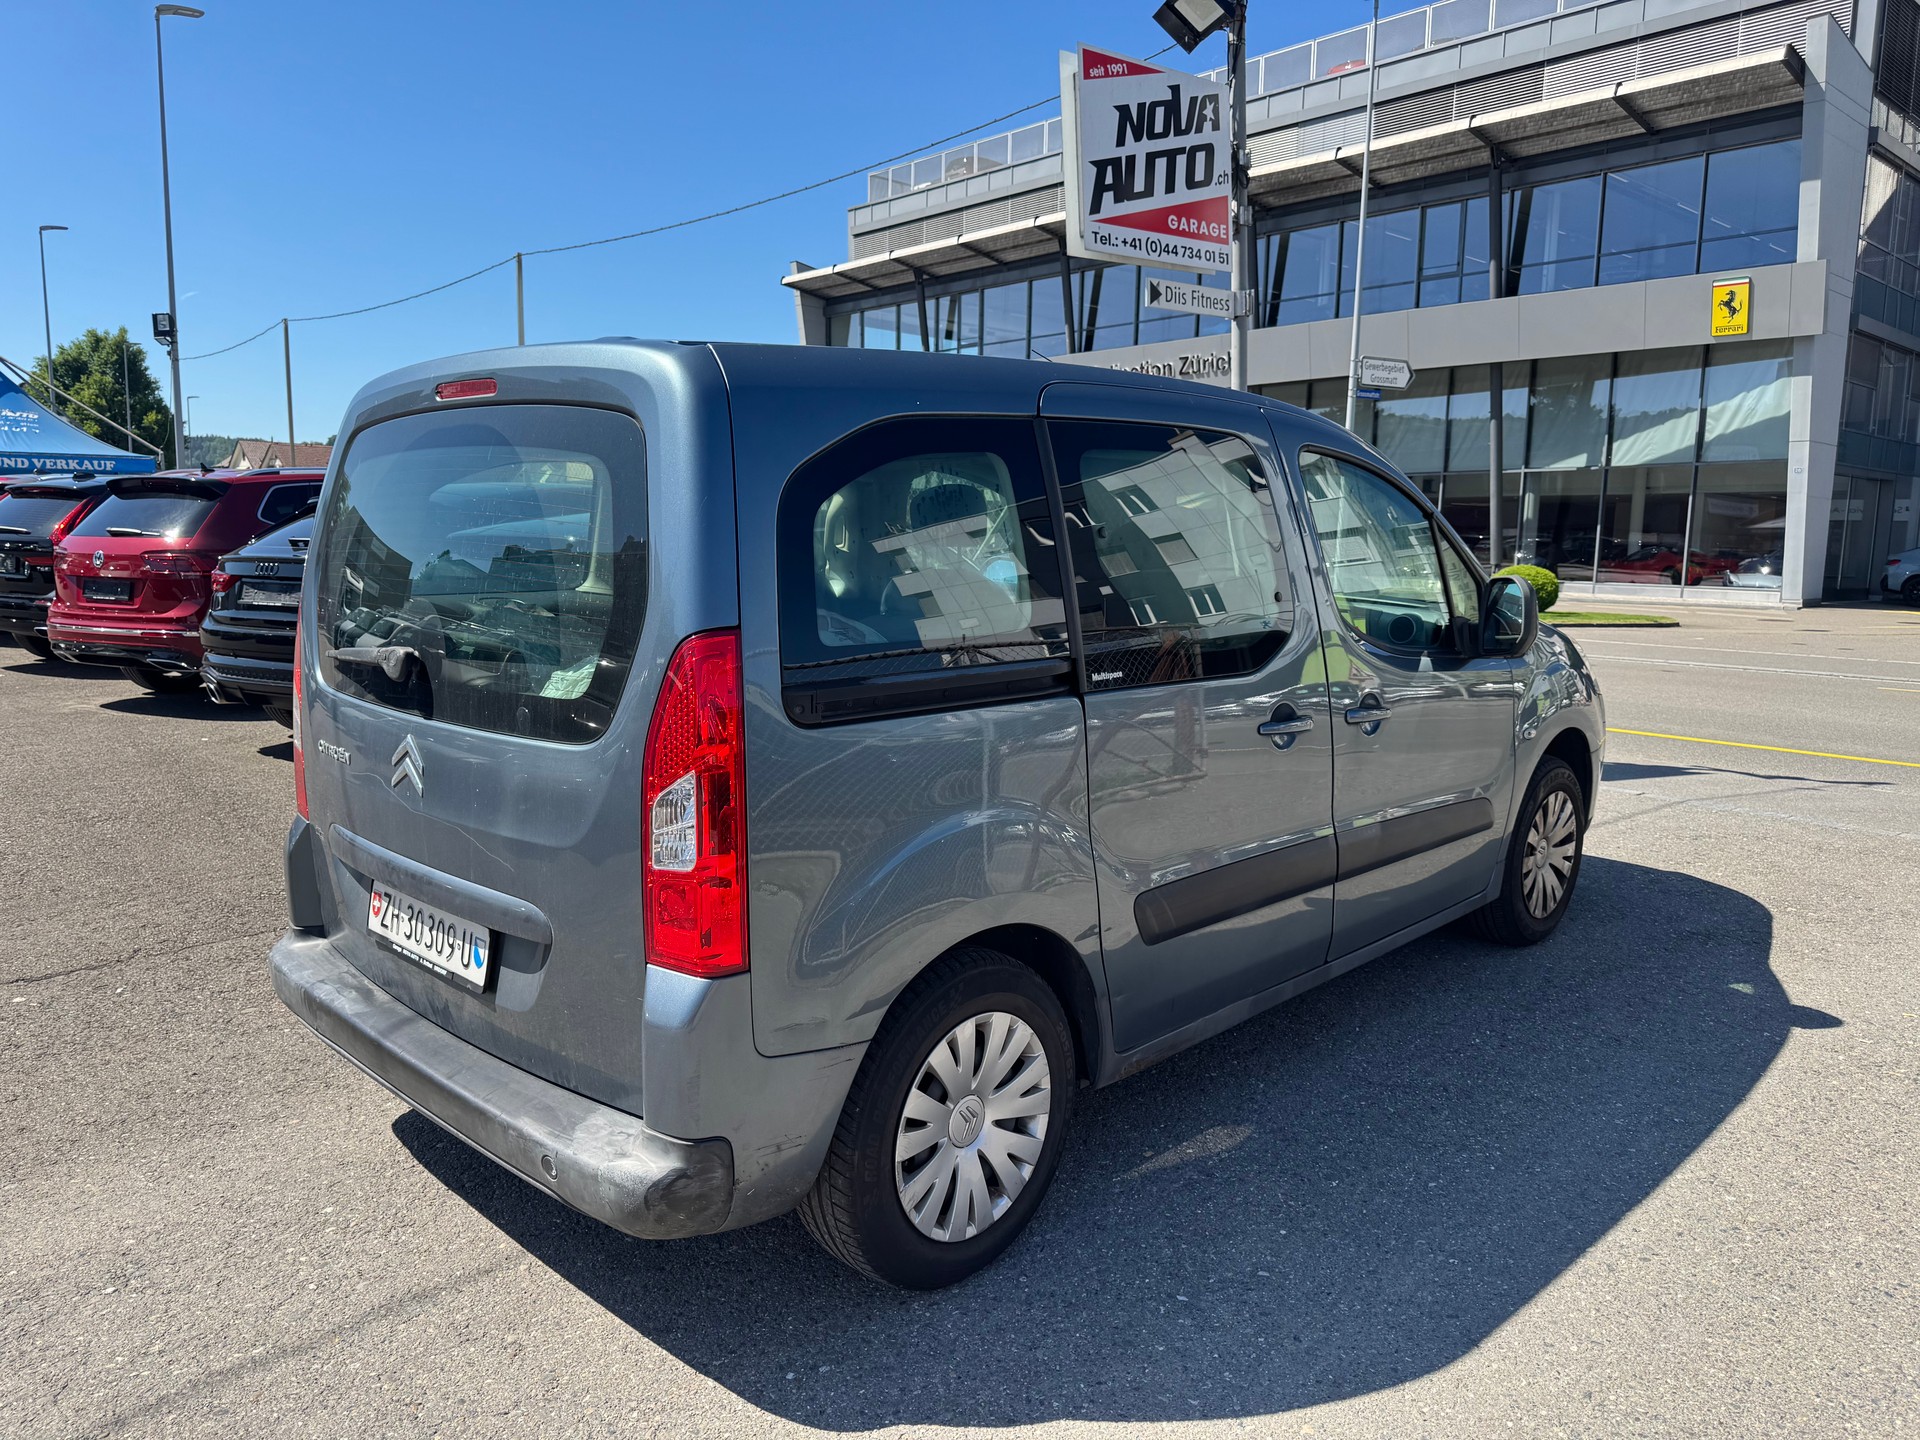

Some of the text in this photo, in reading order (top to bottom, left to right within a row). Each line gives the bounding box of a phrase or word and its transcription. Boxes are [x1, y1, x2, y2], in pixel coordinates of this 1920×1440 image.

[1089, 63, 1128, 77] seit 1991
[1112, 84, 1220, 148] NOVA
[1088, 142, 1215, 216] AUTO
[1167, 214, 1227, 239] GARAGE
[1091, 230, 1229, 265] Tel.: +41 (0)44 734 01 51
[1165, 285, 1230, 312] Diis Fitness
[1715, 324, 1744, 334] Ferrari
[1364, 360, 1405, 375] Gewerbegebiet
[1370, 373, 1398, 385] Grossmatt
[31, 458, 116, 471] VERKAUF
[1091, 670, 1123, 682] Multispace
